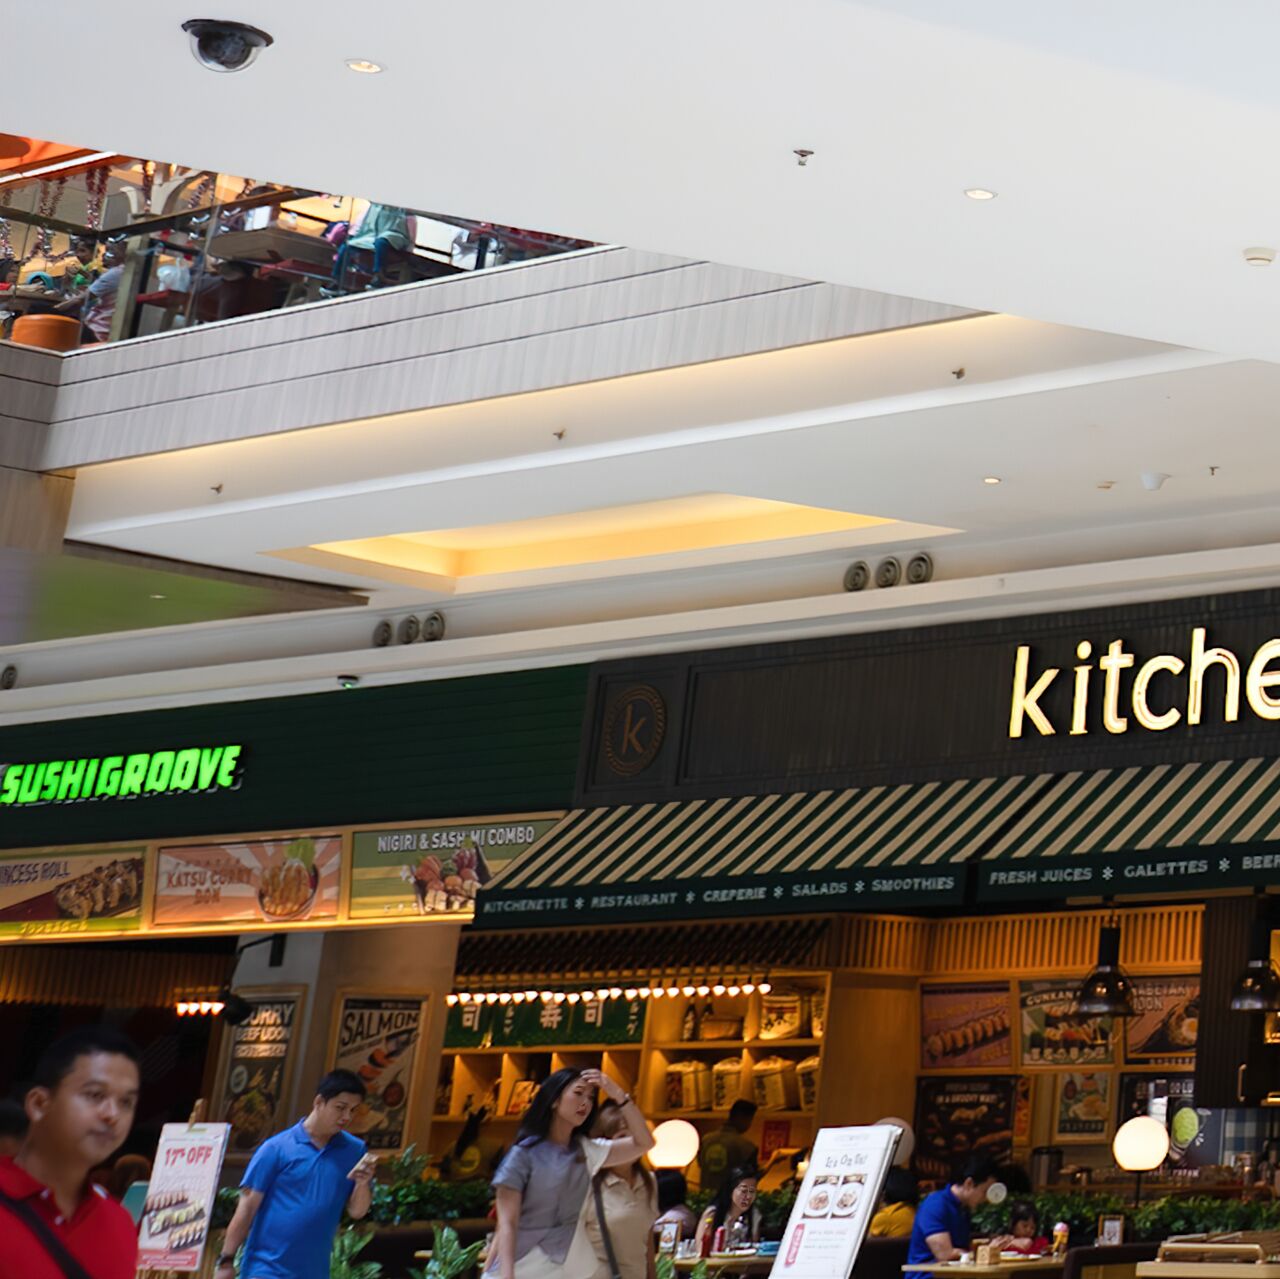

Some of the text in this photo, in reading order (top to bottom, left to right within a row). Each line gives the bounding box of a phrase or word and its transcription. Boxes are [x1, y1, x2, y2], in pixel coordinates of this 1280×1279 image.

[377, 833, 418, 853] NIGIRI
[419, 833, 430, 850] &
[487, 826, 535, 846] COMBO
[988, 869, 1037, 886] FRESH
[1040, 867, 1093, 884] JUICES
[1124, 860, 1209, 879] GALETTES
[483, 876, 955, 913] KITCHENETTE RESTAURANT CREPERIE SALADS SMOOTHIES
[239, 1003, 294, 1027] URRY
[342, 1010, 419, 1047] SALMON
[186, 1145, 214, 1166] OFF
